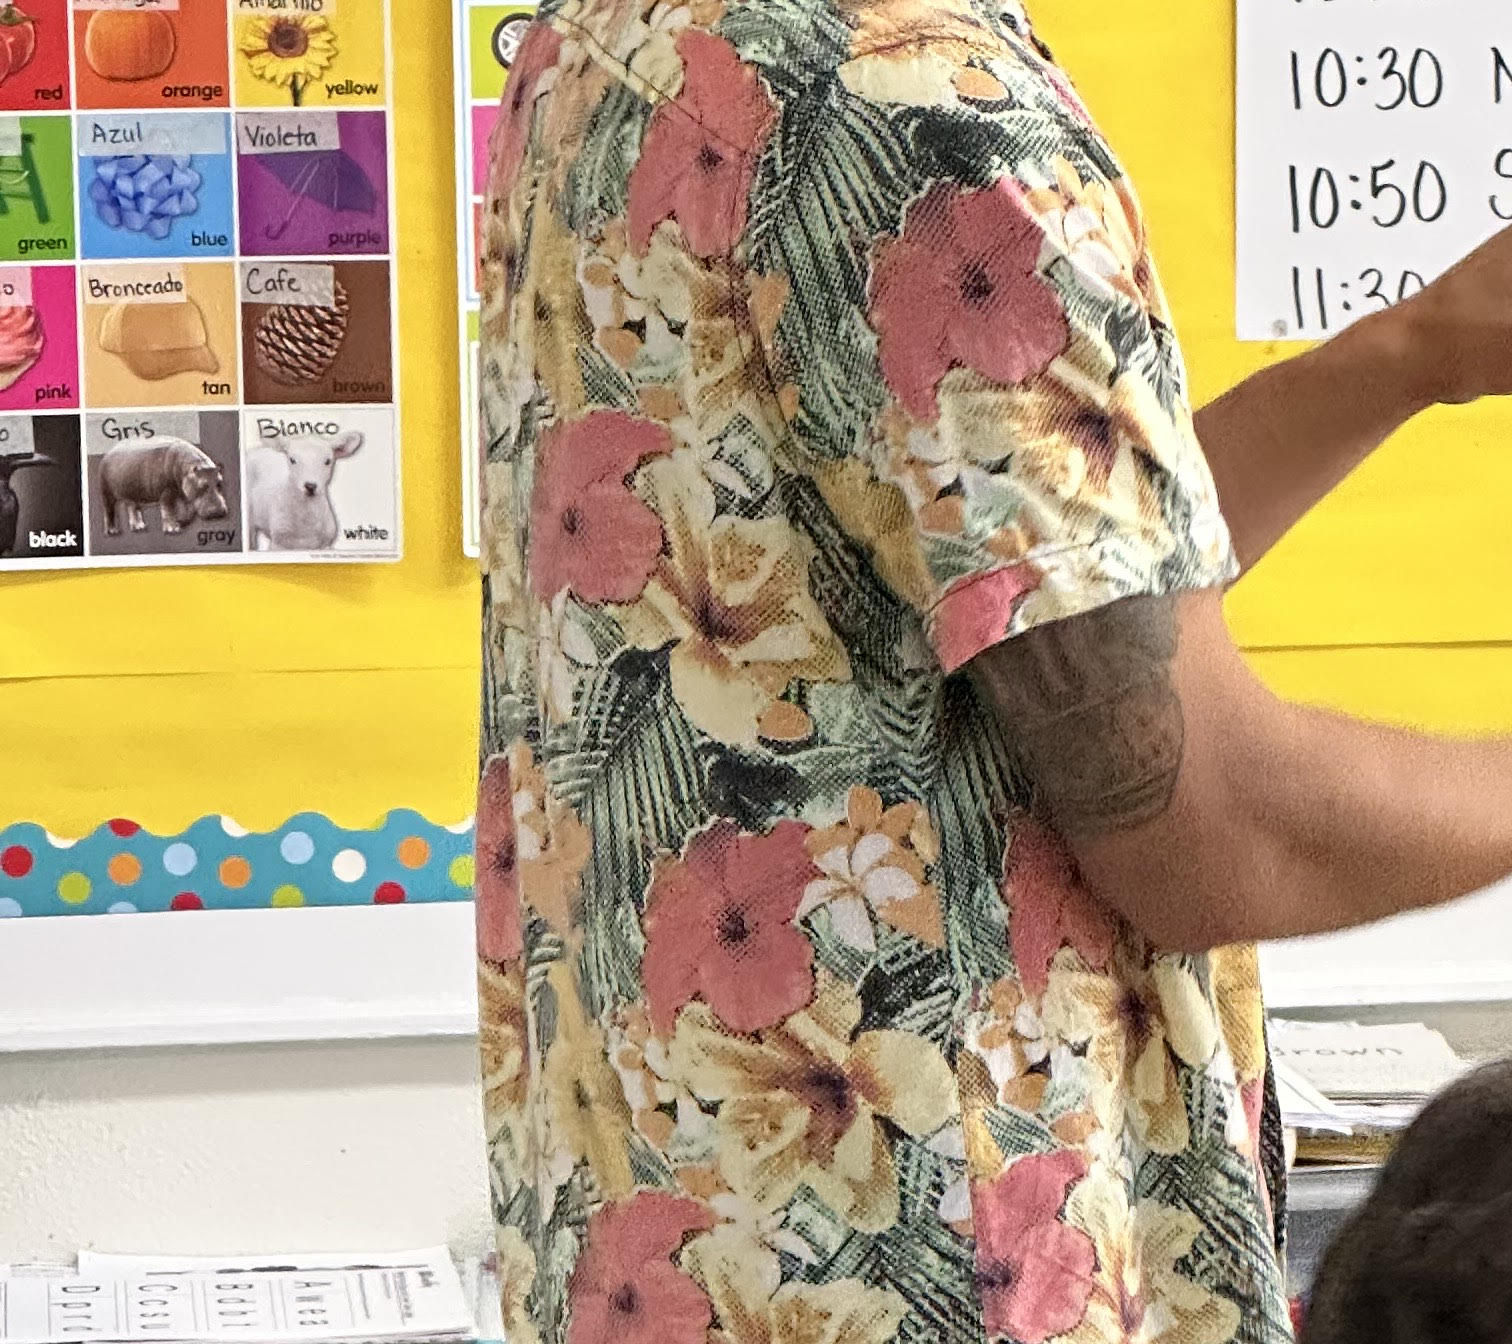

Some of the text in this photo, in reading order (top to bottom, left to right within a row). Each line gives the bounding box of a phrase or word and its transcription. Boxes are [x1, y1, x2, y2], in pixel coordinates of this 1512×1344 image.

[1289, 46, 1444, 111] 10:30
[34, 85, 63, 100] red
[161, 84, 223, 101] orange
[325, 80, 379, 98] yellow
[92, 122, 143, 143] Azul
[245, 124, 317, 147] Violeta
[1288, 158, 1447, 233] 10:50
[18, 236, 68, 252] green
[191, 231, 228, 247] blue
[328, 231, 381, 247] purple
[88, 272, 183, 298] Bronceado
[246, 267, 301, 294] Cafe
[35, 384, 72, 402] pink
[202, 381, 231, 396] tan
[332, 378, 386, 394] brown
[101, 418, 155, 440] Gris
[256, 418, 339, 439] Blanco
[29, 530, 77, 548] black
[197, 529, 235, 545] gray
[343, 525, 389, 540] white
